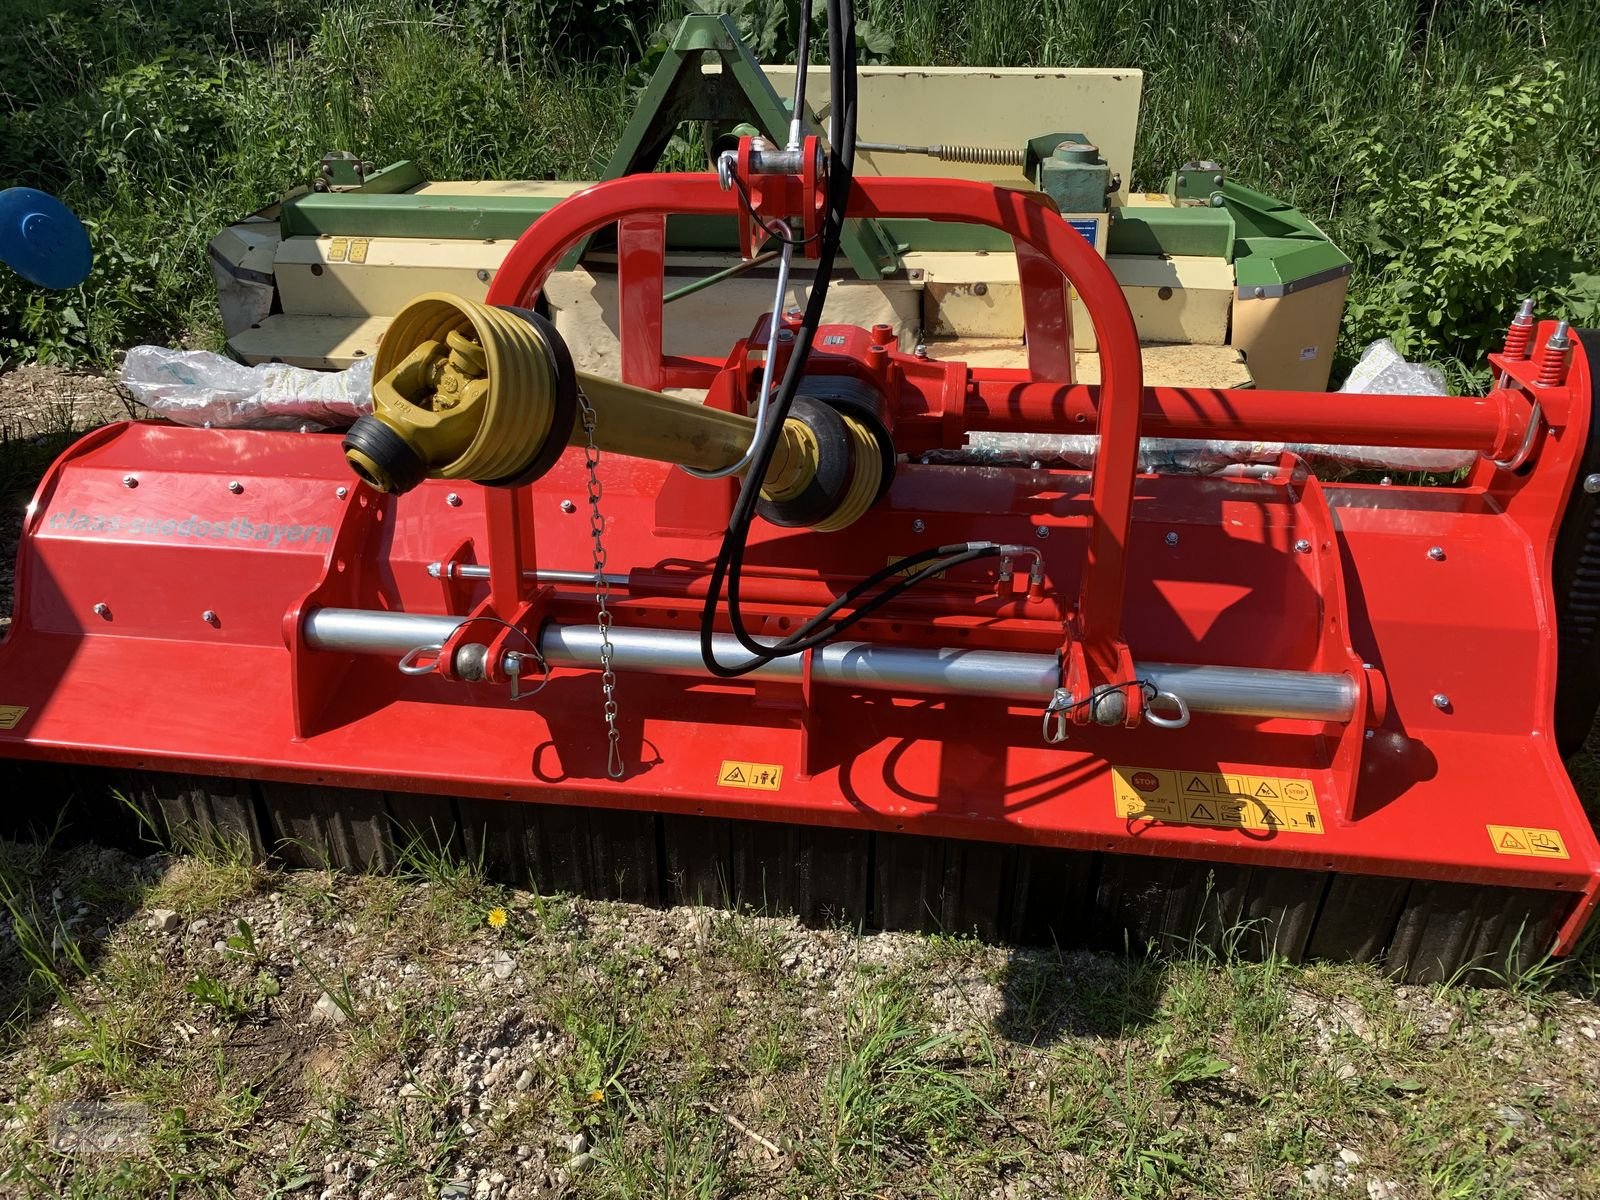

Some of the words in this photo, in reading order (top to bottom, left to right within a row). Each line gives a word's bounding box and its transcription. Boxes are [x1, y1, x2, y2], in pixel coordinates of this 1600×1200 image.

[49, 507, 334, 548] claas-suedostbayern
[1135, 777, 1157, 787] STOP
[1288, 788, 1306, 796] STOP
